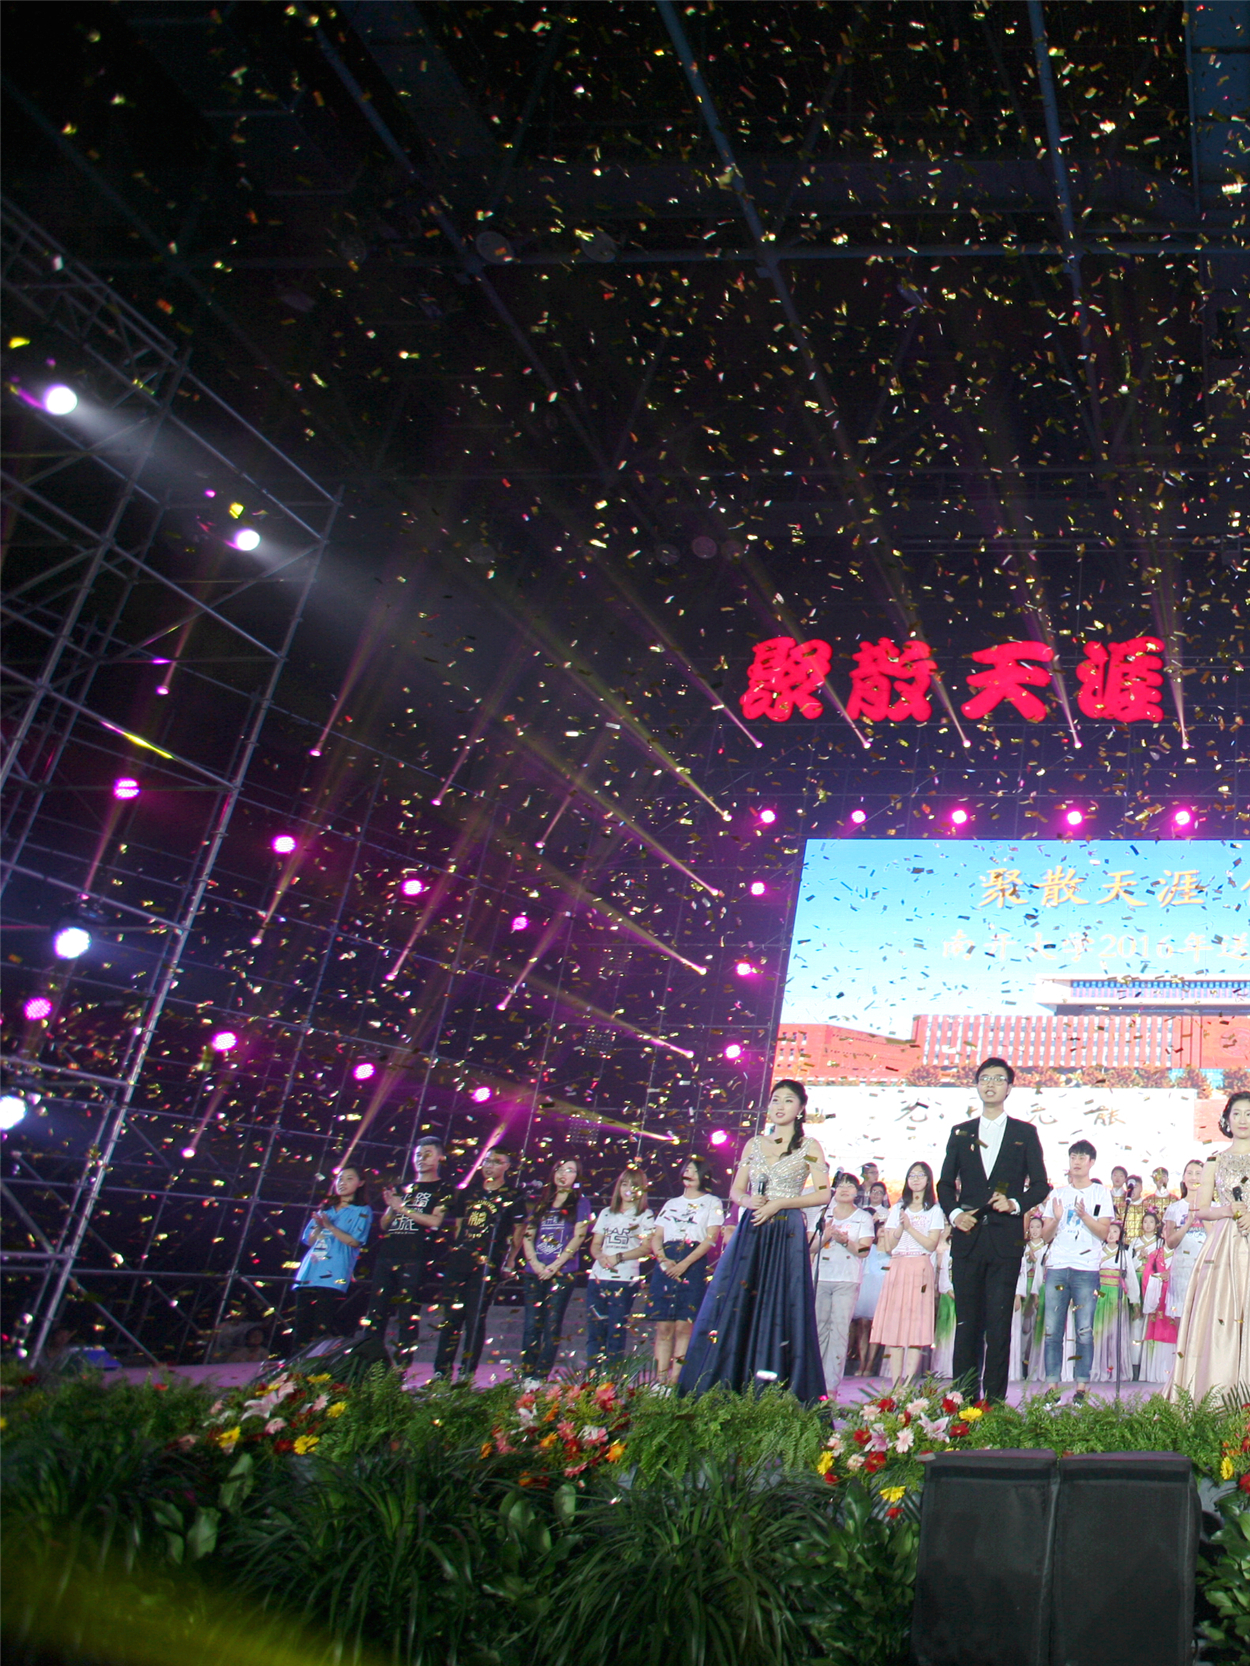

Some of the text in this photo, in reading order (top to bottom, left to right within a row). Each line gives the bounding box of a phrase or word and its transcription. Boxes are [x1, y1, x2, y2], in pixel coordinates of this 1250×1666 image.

[740, 636, 1164, 723] 聚散天涯
[978, 865, 1205, 909] 聚散天涯
[895, 1098, 1126, 1125] 允允能
